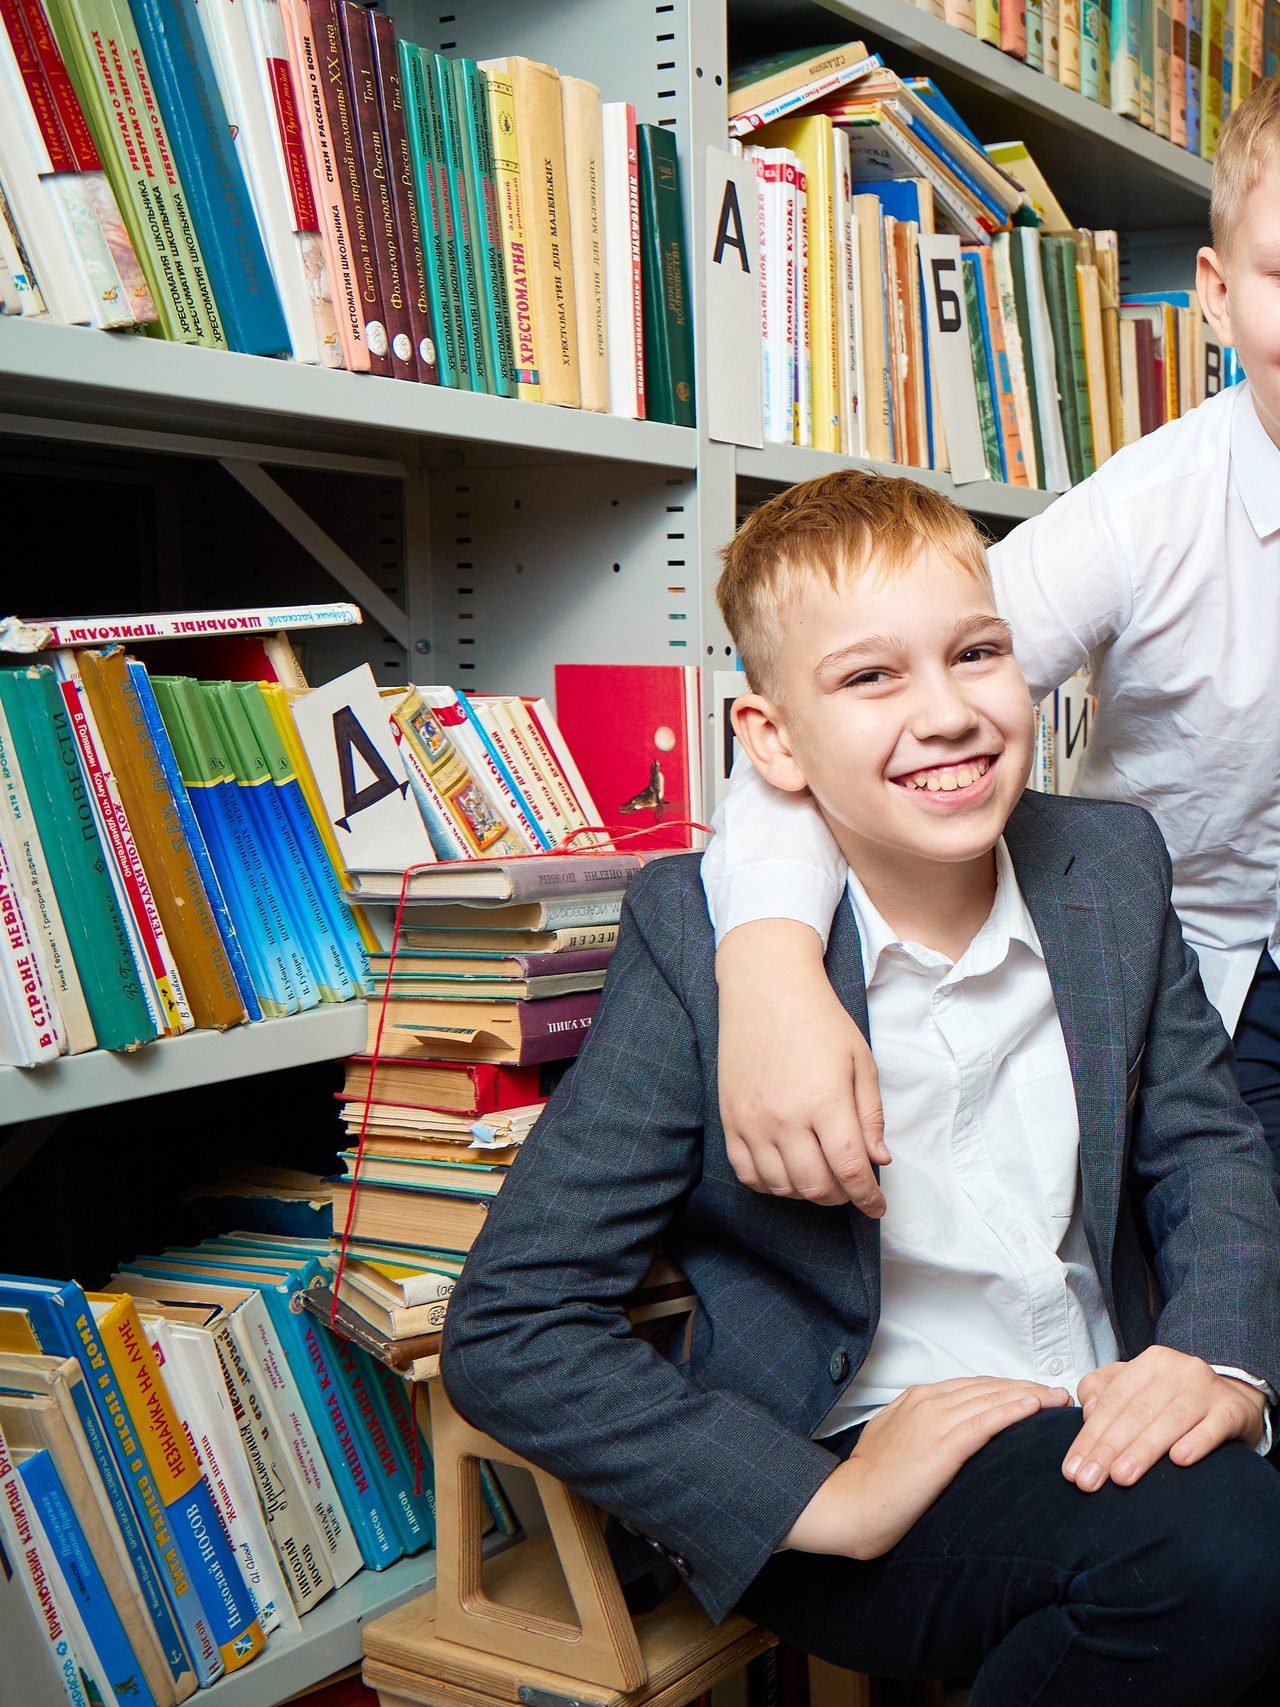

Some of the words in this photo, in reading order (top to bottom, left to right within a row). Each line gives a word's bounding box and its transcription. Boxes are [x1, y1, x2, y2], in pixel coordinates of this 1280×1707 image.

[91, 30, 117, 96] ЗВЕРЯТАХ
[303, 35, 315, 71] ВОЙНЕ
[326, 24, 339, 53] века
[108, 38, 133, 103] ЗВЕРЯТАХ
[130, 48, 155, 111] ЗВЕРЯТАХ
[310, 73, 317, 81] О
[363, 79, 375, 104] Том
[113, 98, 121, 108] О
[128, 106, 137, 116] О
[150, 115, 158, 124] О
[312, 83, 328, 138] РАССКАЗЫ
[337, 88, 353, 154] половины
[393, 86, 403, 112] Том
[116, 112, 140, 171] РЕБЯТАМ
[132, 119, 155, 178] РЕБЯТАМ
[153, 128, 176, 185] РЕБЯТАМ
[321, 140, 329, 149] И
[323, 152, 334, 183] СТИХИ
[372, 130, 387, 180] России
[401, 138, 414, 187] России
[628, 148, 636, 160] 2
[343, 156, 365, 206] первой
[426, 161, 435, 193] РОДИНА
[429, 192, 437, 211] МОЯ
[440, 167, 450, 199] РОДИНА
[457, 172, 465, 202] РОДИНА
[513, 177, 523, 229] родителей
[544, 157, 558, 238] МАЛЕНЬКИХ
[589, 159, 599, 235] МАЛЕНЬКИХ
[138, 180, 165, 251] ШКОЛЬНИКА
[152, 186, 180, 256] ШКОЛЬНИКА
[173, 193, 200, 262] ШКОЛЬНИКА
[355, 205, 368, 242] юмор
[380, 183, 394, 237] народов
[407, 190, 420, 244] народов
[431, 209, 439, 232] ТИХАЯ
[443, 197, 451, 214] МОЯ
[445, 214, 453, 237] ТИХАЯ
[461, 219, 469, 241] ТИХАЯ
[713, 179, 750, 273] А
[786, 199, 794, 252] КУЗЬКА
[331, 204, 349, 271] ШКОЛЬНИКА
[361, 244, 369, 253] и
[553, 243, 562, 271] ДЛЯ
[592, 240, 601, 267] ДЛЯ
[361, 253, 377, 303] Сатира
[385, 240, 403, 309] Фольклор
[412, 246, 429, 314] Фольклор
[433, 235, 447, 298] ШКОЛЬНИКА
[446, 240, 460, 302] ШКОЛЬНИКА
[463, 245, 477, 306] ШКОЛЬНИКА
[160, 255, 191, 333] ХРЕСТОМАТИЯ
[174, 261, 205, 338] ХРЕСТОМАТИЯ
[193, 266, 224, 343] ХРЕСТОМАТИЯ
[343, 272, 362, 341] ХРЕСТОМАТИЯ
[511, 241, 535, 366] ХРЕСТОМАТИЯ
[552, 276, 571, 366] ХРЕСТОМАТИЯ
[592, 271, 604, 358] ХРЕСТОМАТИЯ
[758, 253, 768, 339] ДОМОВЁНОК
[786, 259, 794, 345] ДОМОВЁНОК
[930, 258, 961, 332] Б
[440, 300, 457, 371] ХРЕСТОМАТИЯ
[454, 304, 468, 375] ХРЕСТОМАТИЯ
[469, 308, 484, 377] ХРЕСТОМАТИЯ
[1204, 341, 1221, 398] В
[171, 615, 262, 634] ШКОЛЬНЫЕ
[267, 611, 315, 628] рассказов
[315, 609, 354, 623] Сборник
[74, 712, 84, 725] В.
[120, 680, 169, 793] ПОВЕСТИ
[1064, 696, 1088, 759] И
[77, 724, 97, 768] Голявкин
[332, 704, 410, 833] Д
[481, 750, 511, 796] ШКОЛЕ
[491, 730, 526, 787] ДРАГУНСКИЙ
[509, 727, 544, 783] ДРАГУНСКИЙ
[526, 722, 559, 778] ДРАГУНСКИЙ
[52, 711, 97, 842] ПОВЕСТИ
[93, 771, 107, 798] Кому
[541, 786, 561, 818] ВИКТОР
[559, 780, 577, 813] ВИКТОР
[9, 795, 22, 819] КАТЯ
[102, 798, 112, 815] что
[160, 802, 182, 853] ТРИ
[522, 788, 544, 822] ВИКТОР
[23, 840, 37, 887] Ягдфельд
[105, 816, 132, 878] удивительно
[233, 828, 251, 872] КРИВЫХ
[241, 827, 264, 870] КРИВЫХ
[304, 824, 326, 863] КРИВЫХ
[183, 865, 213, 940] ГОЛЯВКИН
[322, 867, 354, 931] КОРОЛЕВСТВО
[583, 870, 623, 882] ОНЕГИН
[34, 888, 51, 930] Григорий
[248, 874, 276, 945] КОРОЛЕВСТВО
[259, 872, 290, 942] КОРОЛЕВСТВО
[49, 937, 62, 969] Гернет
[569, 931, 615, 947] ПЕСЕН
[56, 967, 69, 993] Нина
[210, 945, 235, 999] ВИКТОР
[39, 1032, 53, 1048] В
[546, 1018, 578, 1034] УЛИЦ
[75, 1313, 106, 1370] ДОМА
[118, 1318, 144, 1364] ЛУНЕ
[218, 1327, 251, 1387] друзей
[304, 1326, 332, 1391] КАША
[135, 1364, 154, 1394] НА
[104, 1390, 137, 1457] ШКОЛЕ
[248, 1394, 263, 1421] его
[352, 1375, 399, 1478] МИШКИНА
[146, 1391, 187, 1479] НЕЗНАЙКА
[200, 1434, 221, 1478] шляпа
[327, 1391, 370, 1495] МИШКИНА
[4, 1478, 34, 1546] КАПИТАНА
[216, 1477, 238, 1525] Живая
[185, 1503, 217, 1563] НОСОВ
[279, 1536, 312, 1600] НИКОЛАЙ
[301, 1543, 323, 1589] НОСОВ
[25, 1547, 64, 1642] ПРИКЛЮЧЕНИЯ
[211, 1559, 242, 1631] Николай
[194, 1620, 214, 1661] Носов
